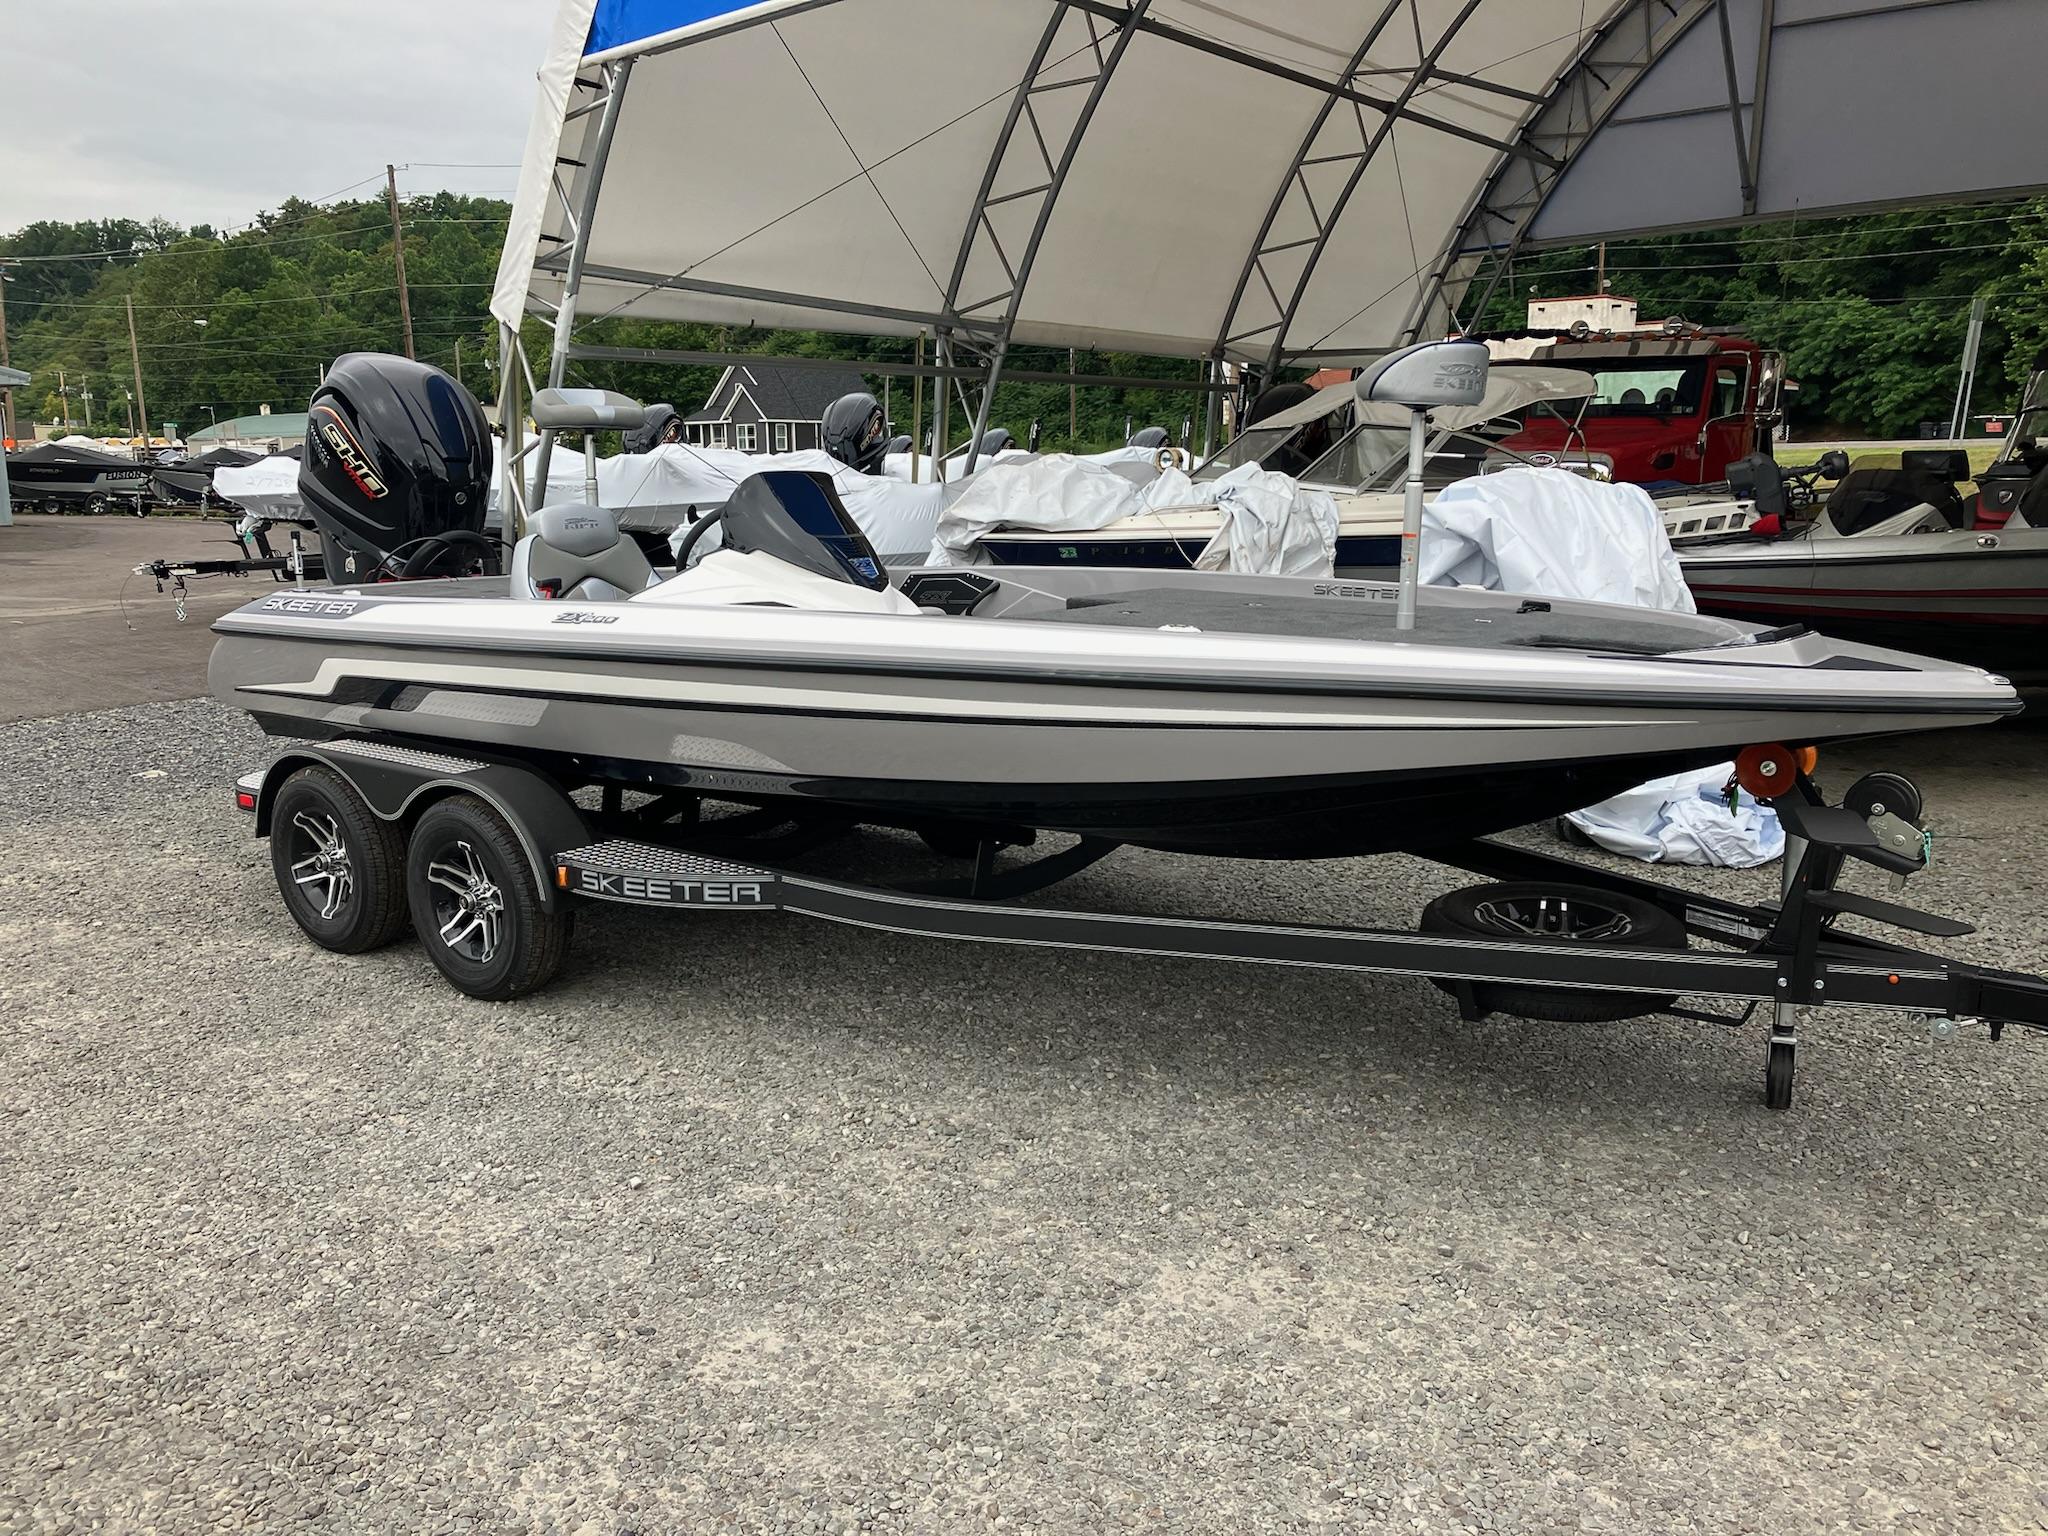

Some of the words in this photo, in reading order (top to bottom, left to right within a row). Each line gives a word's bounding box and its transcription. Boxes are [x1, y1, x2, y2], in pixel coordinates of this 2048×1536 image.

[322, 423, 389, 498] SHO
[261, 597, 358, 615] SKEETER
[581, 869, 762, 903] SKEETER
